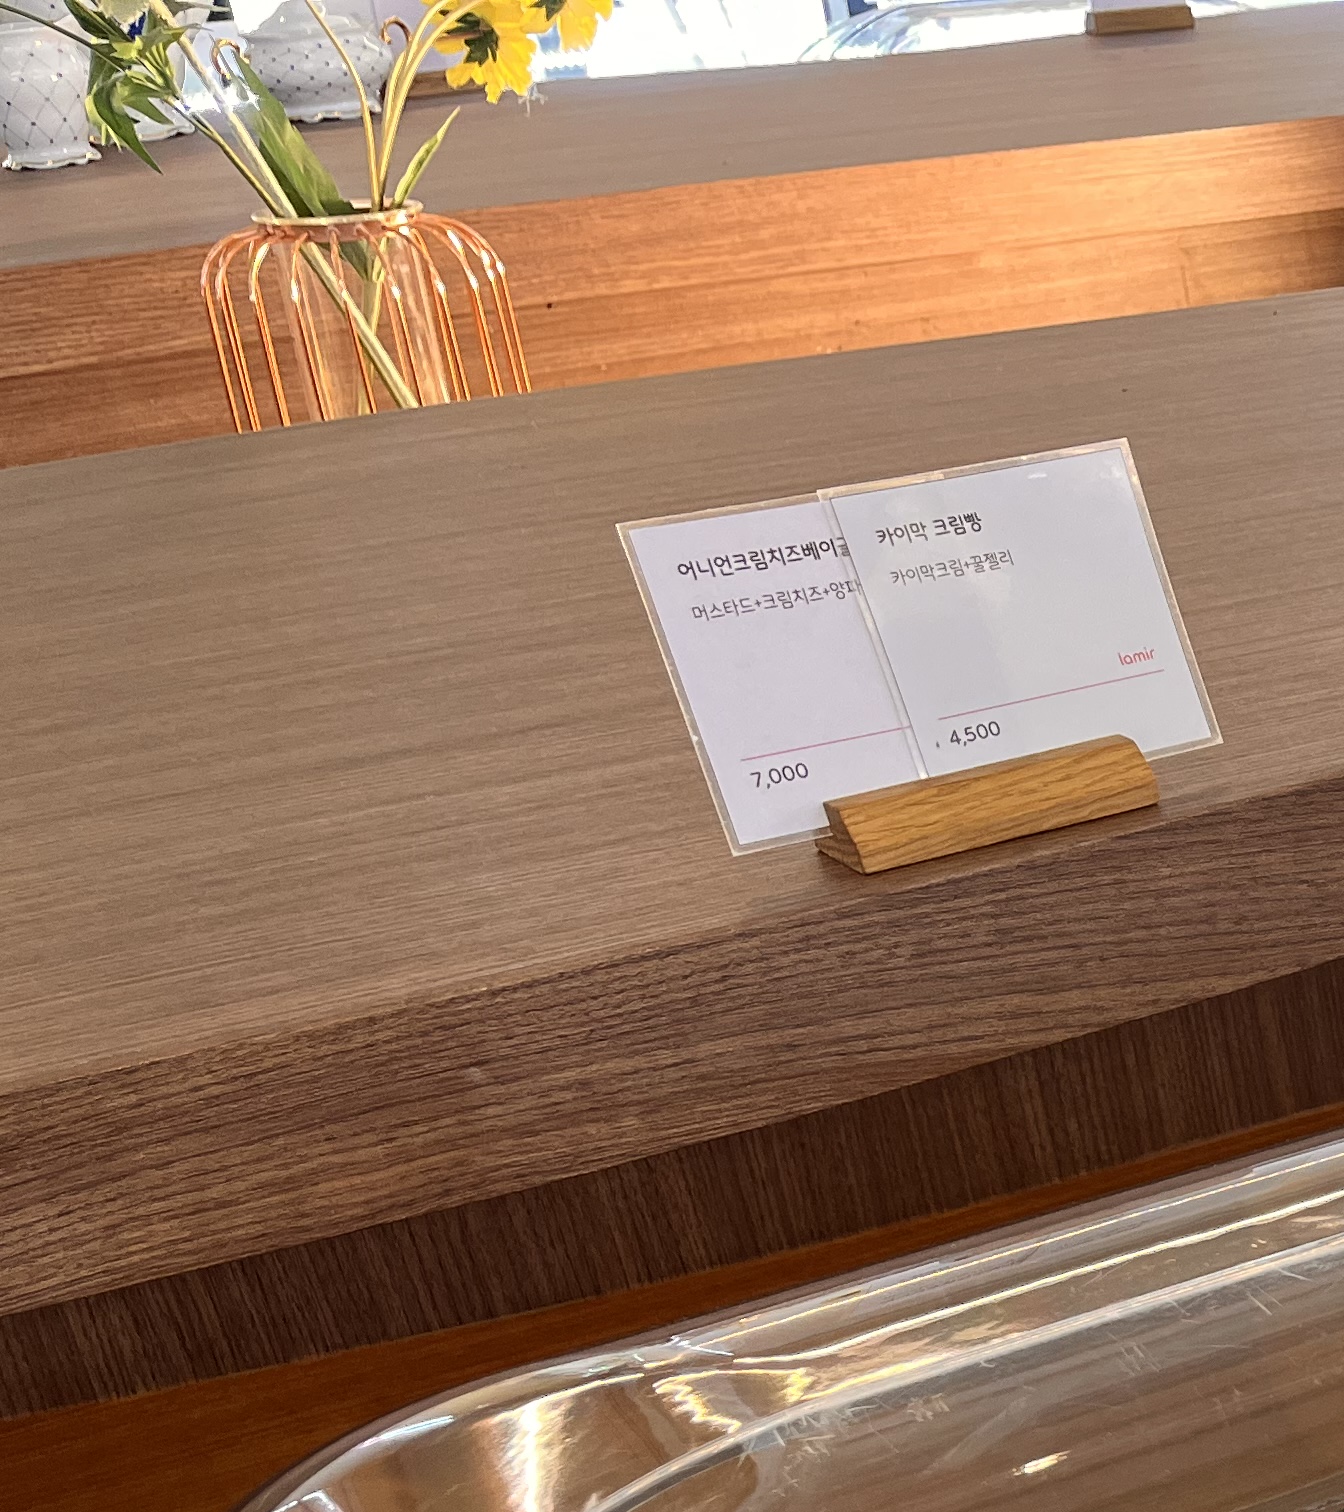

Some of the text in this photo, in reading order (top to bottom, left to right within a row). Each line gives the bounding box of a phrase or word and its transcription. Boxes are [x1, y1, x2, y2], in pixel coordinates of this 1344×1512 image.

[875, 511, 983, 547] 카이막 크림빵
[889, 549, 1015, 587] 카이막크림+꿀젤리
[1118, 646, 1155, 667] lamir
[949, 720, 1001, 748] 4,500
[749, 762, 810, 790] 7,000
